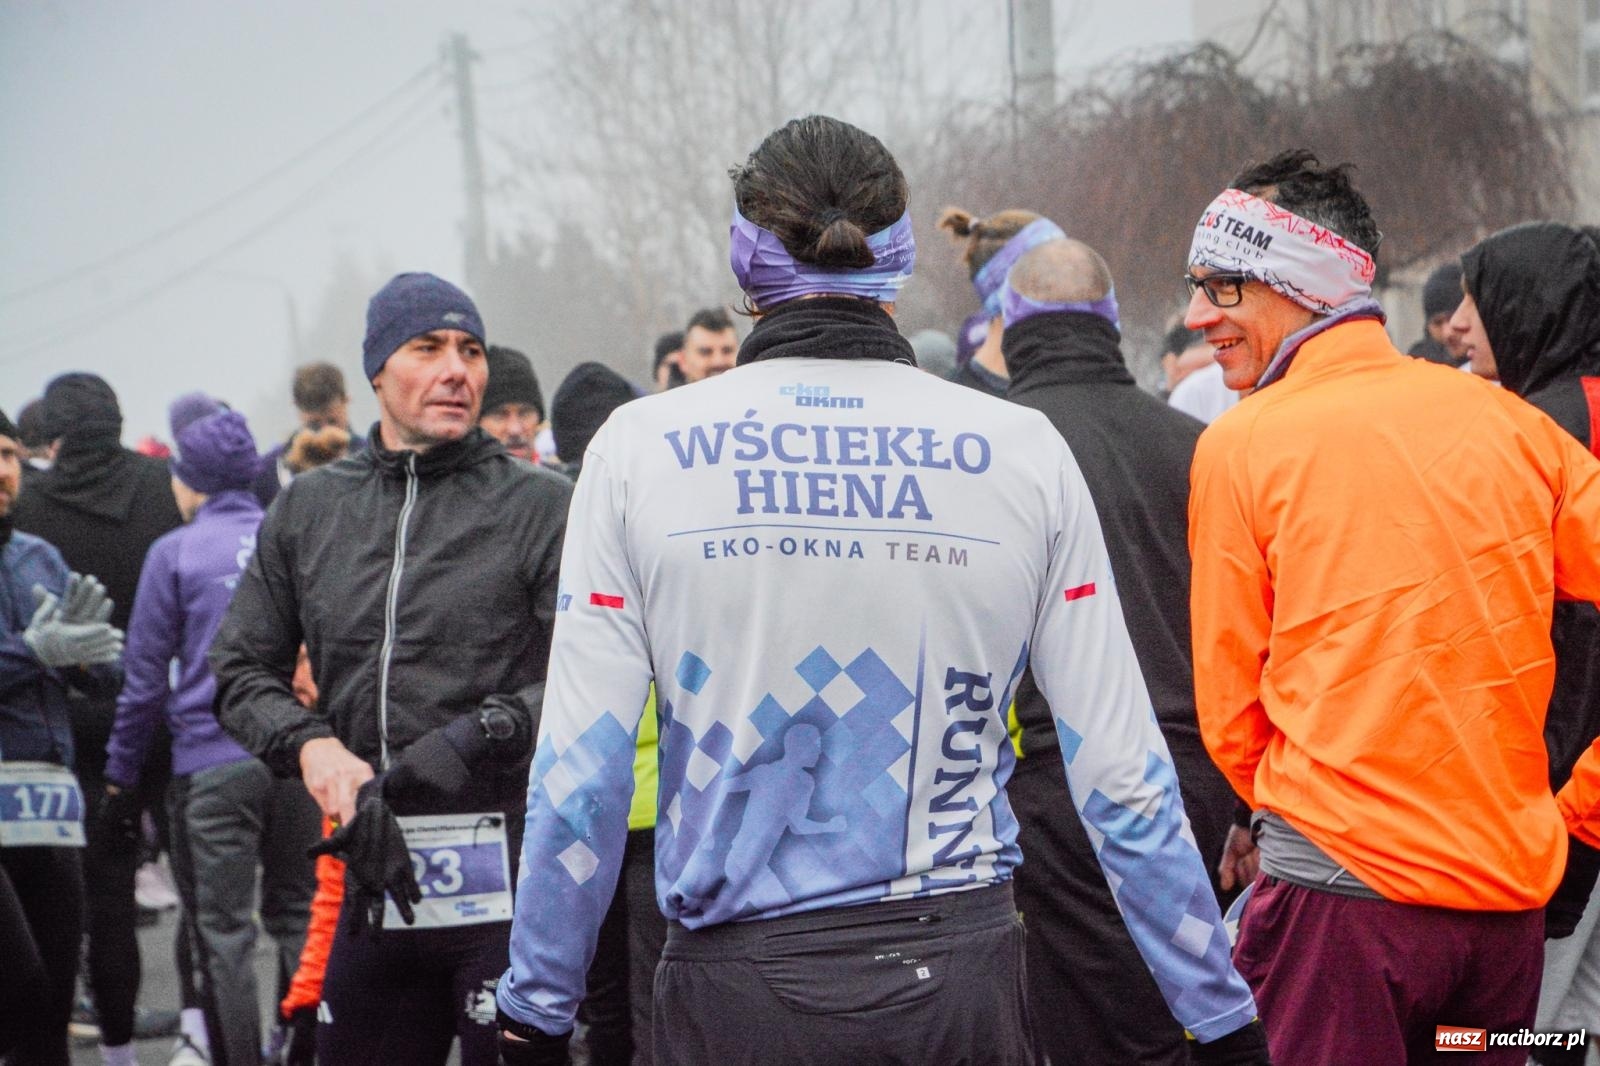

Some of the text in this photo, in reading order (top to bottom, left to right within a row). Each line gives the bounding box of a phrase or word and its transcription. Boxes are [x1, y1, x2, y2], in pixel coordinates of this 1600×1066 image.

[1224, 217, 1274, 251] TEAM
[664, 408, 992, 475] WŚCIEKŁO
[734, 469, 933, 521] HIENA
[703, 537, 969, 567] EKO-OKNA TEAM
[14, 784, 69, 819] 177
